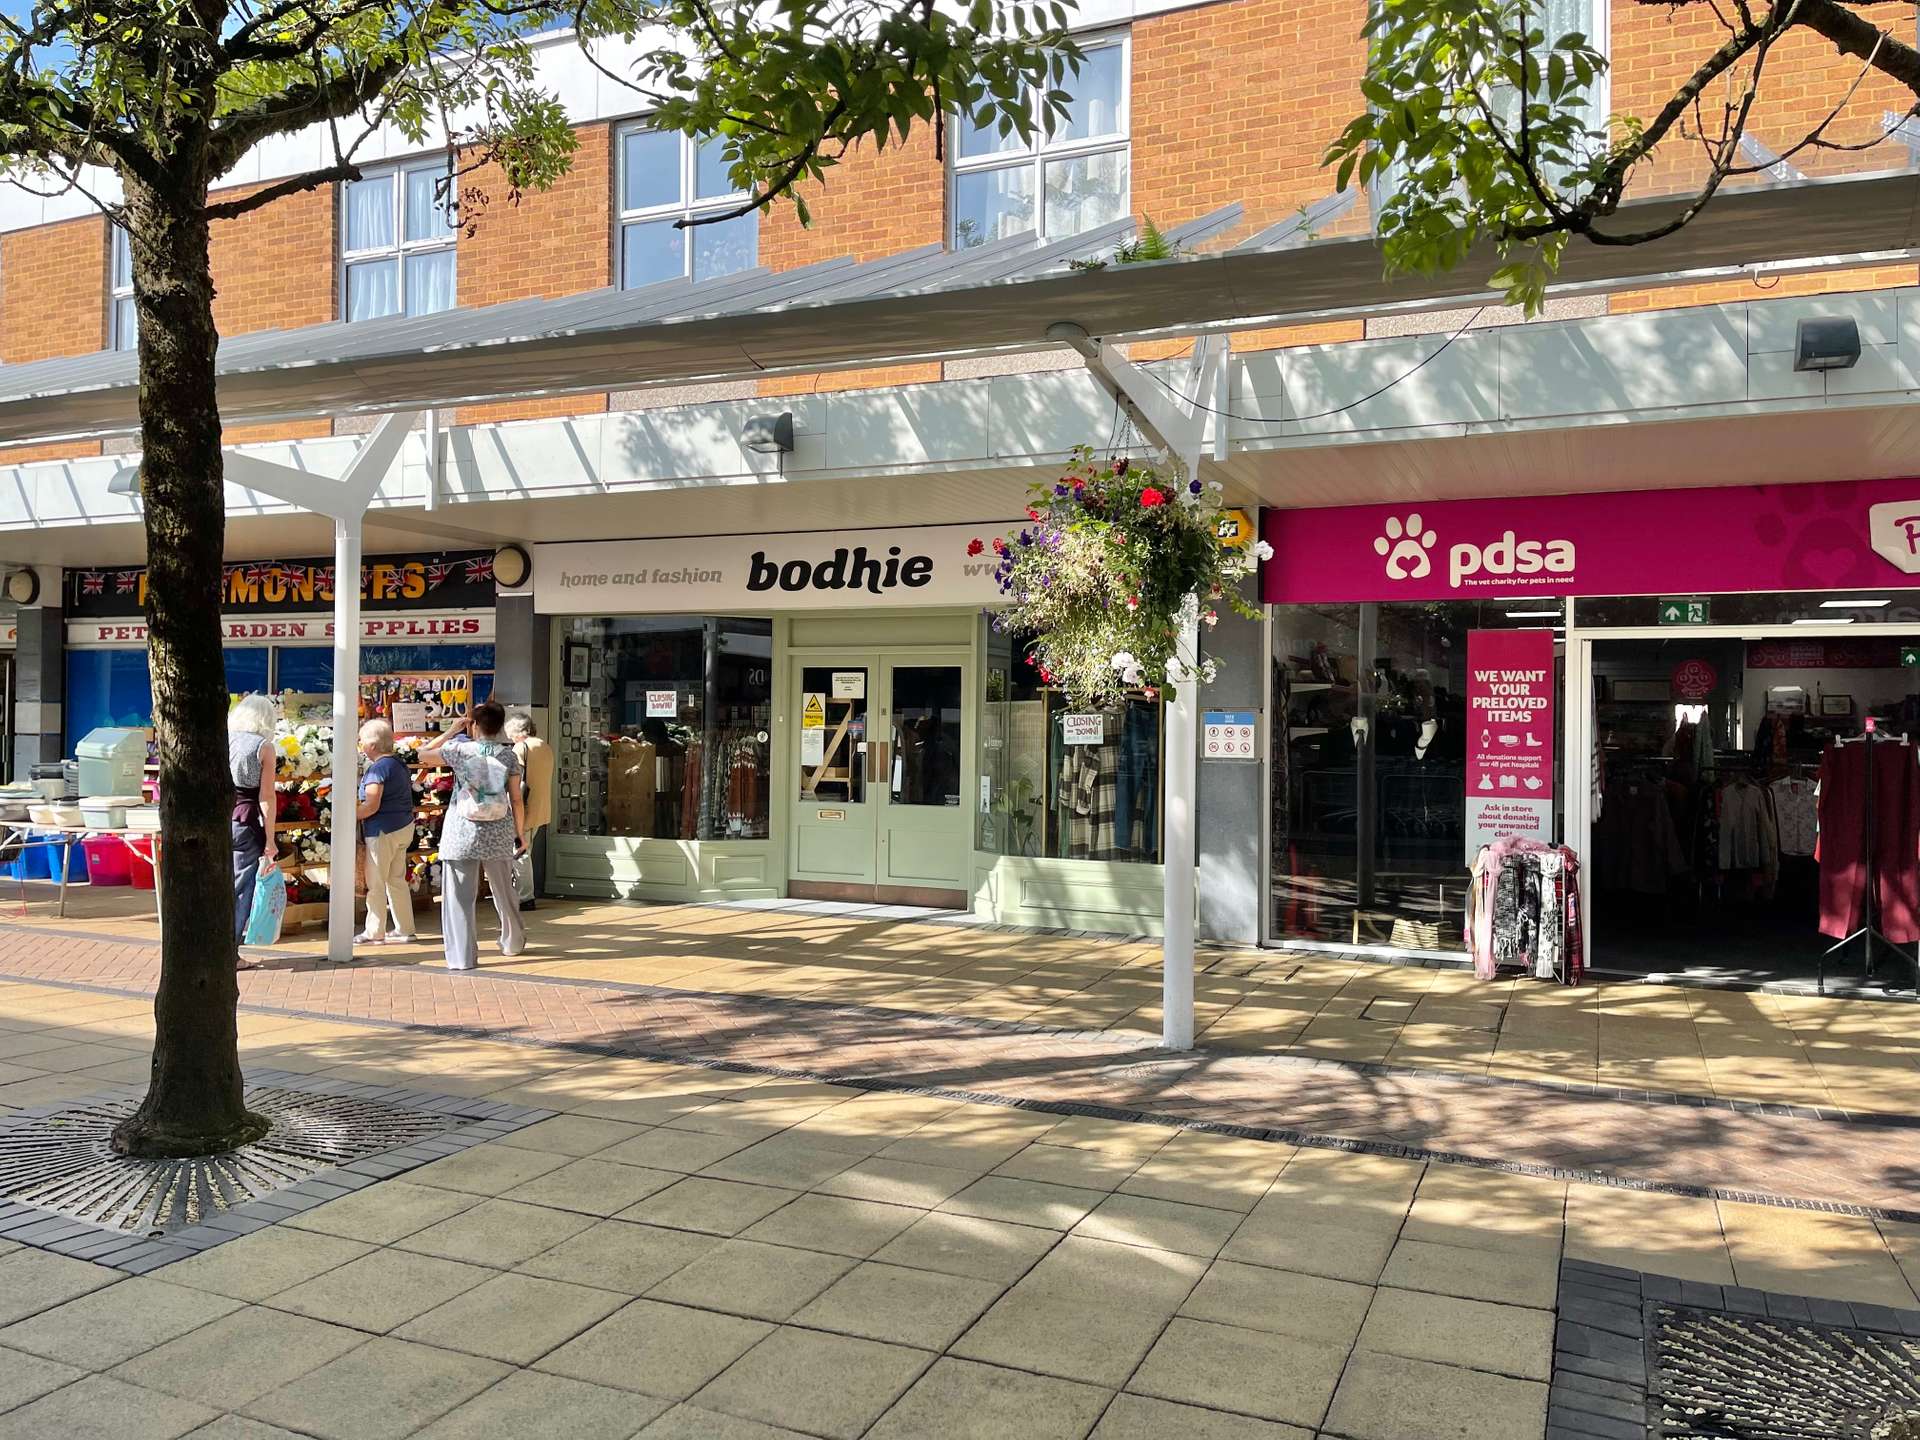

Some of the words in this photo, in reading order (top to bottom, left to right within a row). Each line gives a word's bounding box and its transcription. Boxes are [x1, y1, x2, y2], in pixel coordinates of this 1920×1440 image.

[1450, 530, 1575, 588] pdsa
[746, 546, 934, 594] bodhie
[560, 571, 609, 588] home
[612, 569, 648, 585] and
[651, 567, 723, 585] fashion
[1491, 577, 1517, 586] charity
[1517, 577, 1528, 585] for
[1529, 577, 1546, 585] pets
[1547, 576, 1554, 584] in
[1555, 576, 1575, 584] need
[98, 626, 148, 640] PET
[221, 623, 308, 638] RDEN
[324, 619, 480, 636] SPPLIES
[1474, 670, 1498, 682] WE
[1500, 670, 1547, 682] WANT
[1489, 683, 1530, 695] YOUR
[1472, 697, 1548, 709] PRELOVED
[1066, 716, 1101, 727] CLOSING
[1487, 710, 1532, 723] ITEMS
[1485, 753, 1517, 761] donations
[1502, 813, 1540, 824] donating
[1478, 822, 1497, 830] your
[1498, 822, 1540, 830] unwanted
